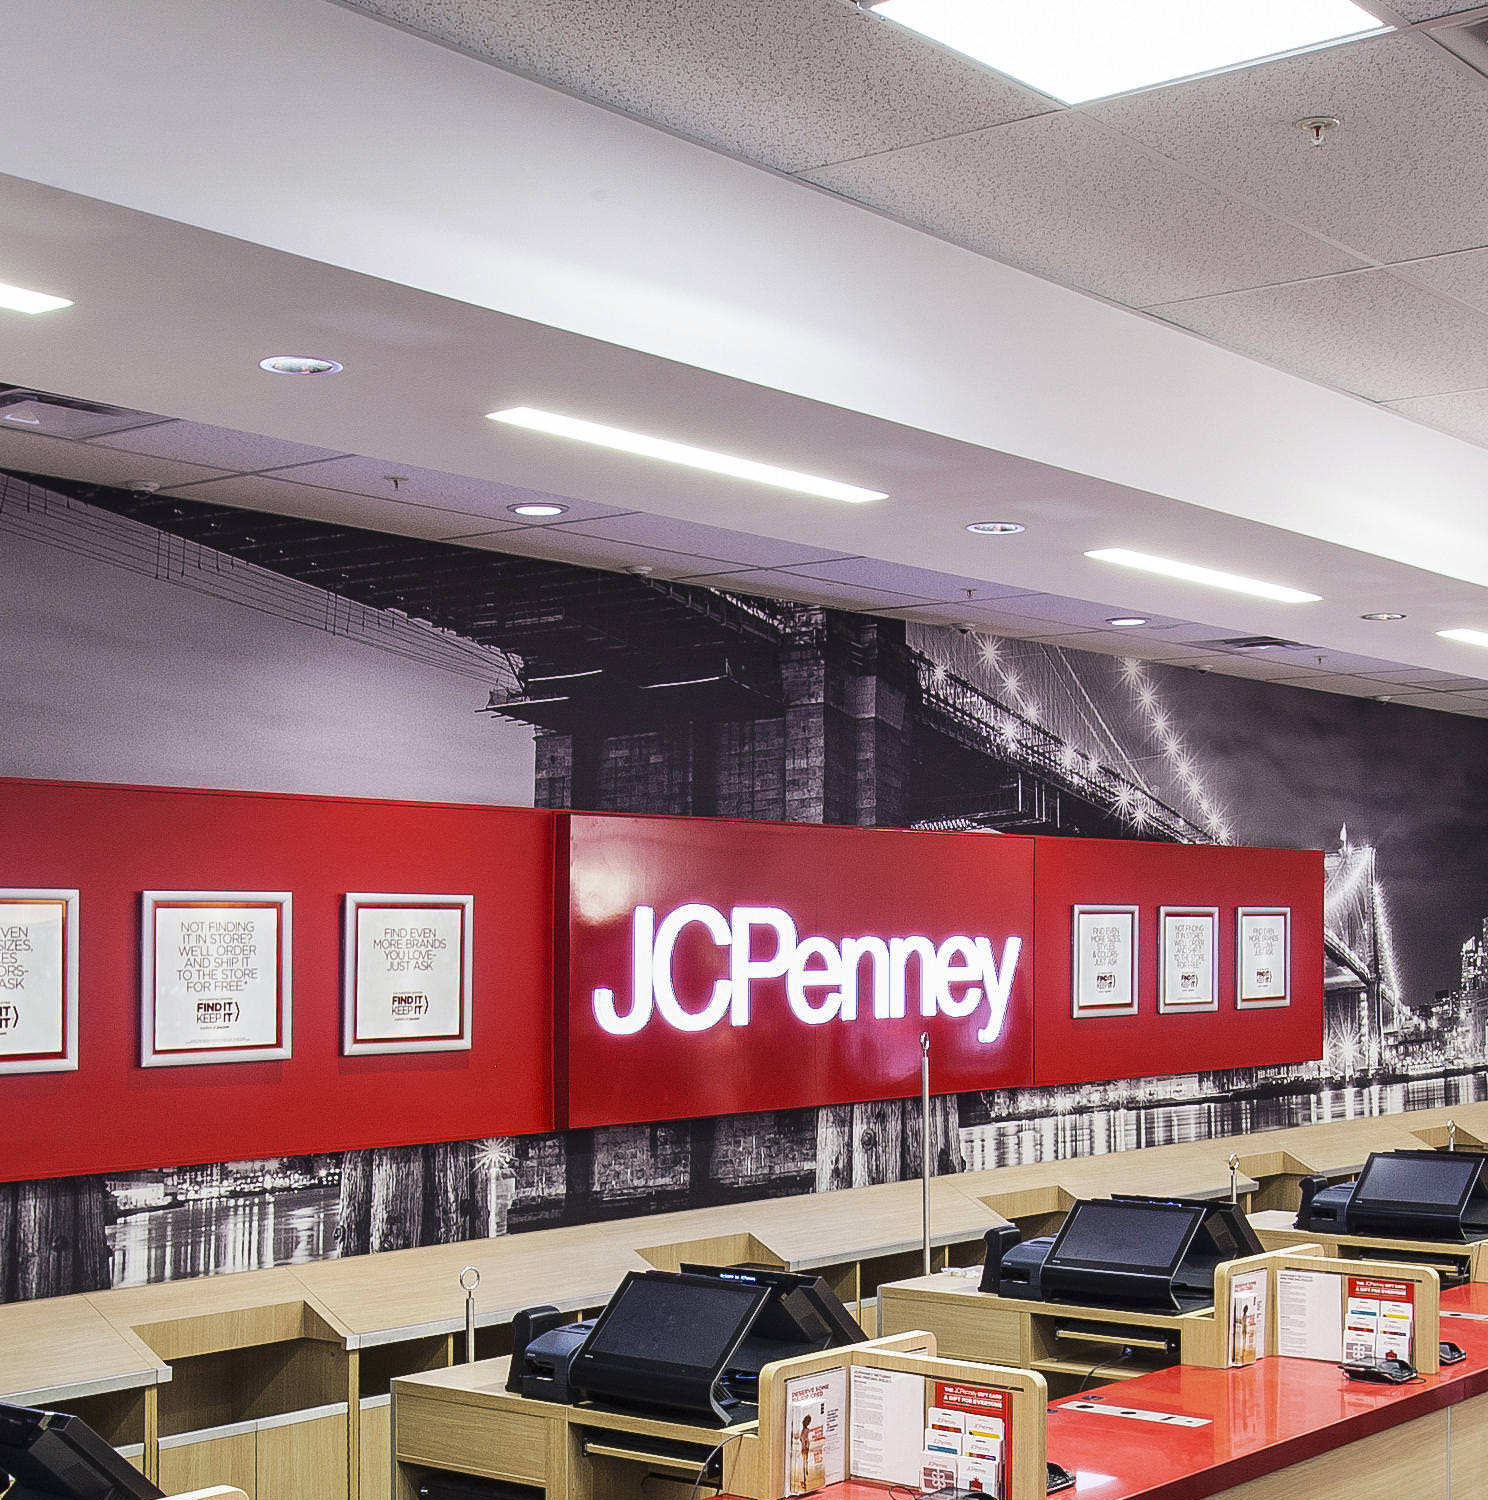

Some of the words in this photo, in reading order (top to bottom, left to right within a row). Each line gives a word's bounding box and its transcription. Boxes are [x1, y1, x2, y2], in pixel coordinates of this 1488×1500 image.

[181, 922, 205, 933] NOT
[208, 921, 255, 932] FINDING
[183, 934, 192, 944] IT
[195, 934, 206, 944] IN
[210, 933, 253, 944] STORE?
[384, 928, 407, 939] FIND
[410, 928, 436, 938] EVEN
[373, 939, 402, 950] MORE
[405, 939, 447, 949] BRANDS
[217, 945, 257, 956] ORDER
[384, 950, 405, 960] YOU
[184, 958, 211, 969] AND
[213, 957, 239, 968] SHIP
[241, 957, 250, 967] IT
[387, 961, 410, 972] JUST
[413, 961, 433, 971] ASK
[176, 970, 193, 981] TO
[196, 969, 218, 980] THE
[221, 968, 258, 980] STORE
[592, 903, 1023, 1043] JCPenney
[186, 981, 211, 993] FOR
[392, 996, 413, 1005] FIND
[414, 996, 423, 1004] IT
[0, 1006, 11, 1017] IT
[197, 1003, 222, 1013] FIND
[223, 1002, 233, 1012] IT
[392, 1006, 412, 1015] KEEP
[414, 1006, 422, 1014] IT
[0, 1018, 11, 1029] IT
[197, 1013, 221, 1024] KEEP
[223, 1013, 232, 1023] IT
